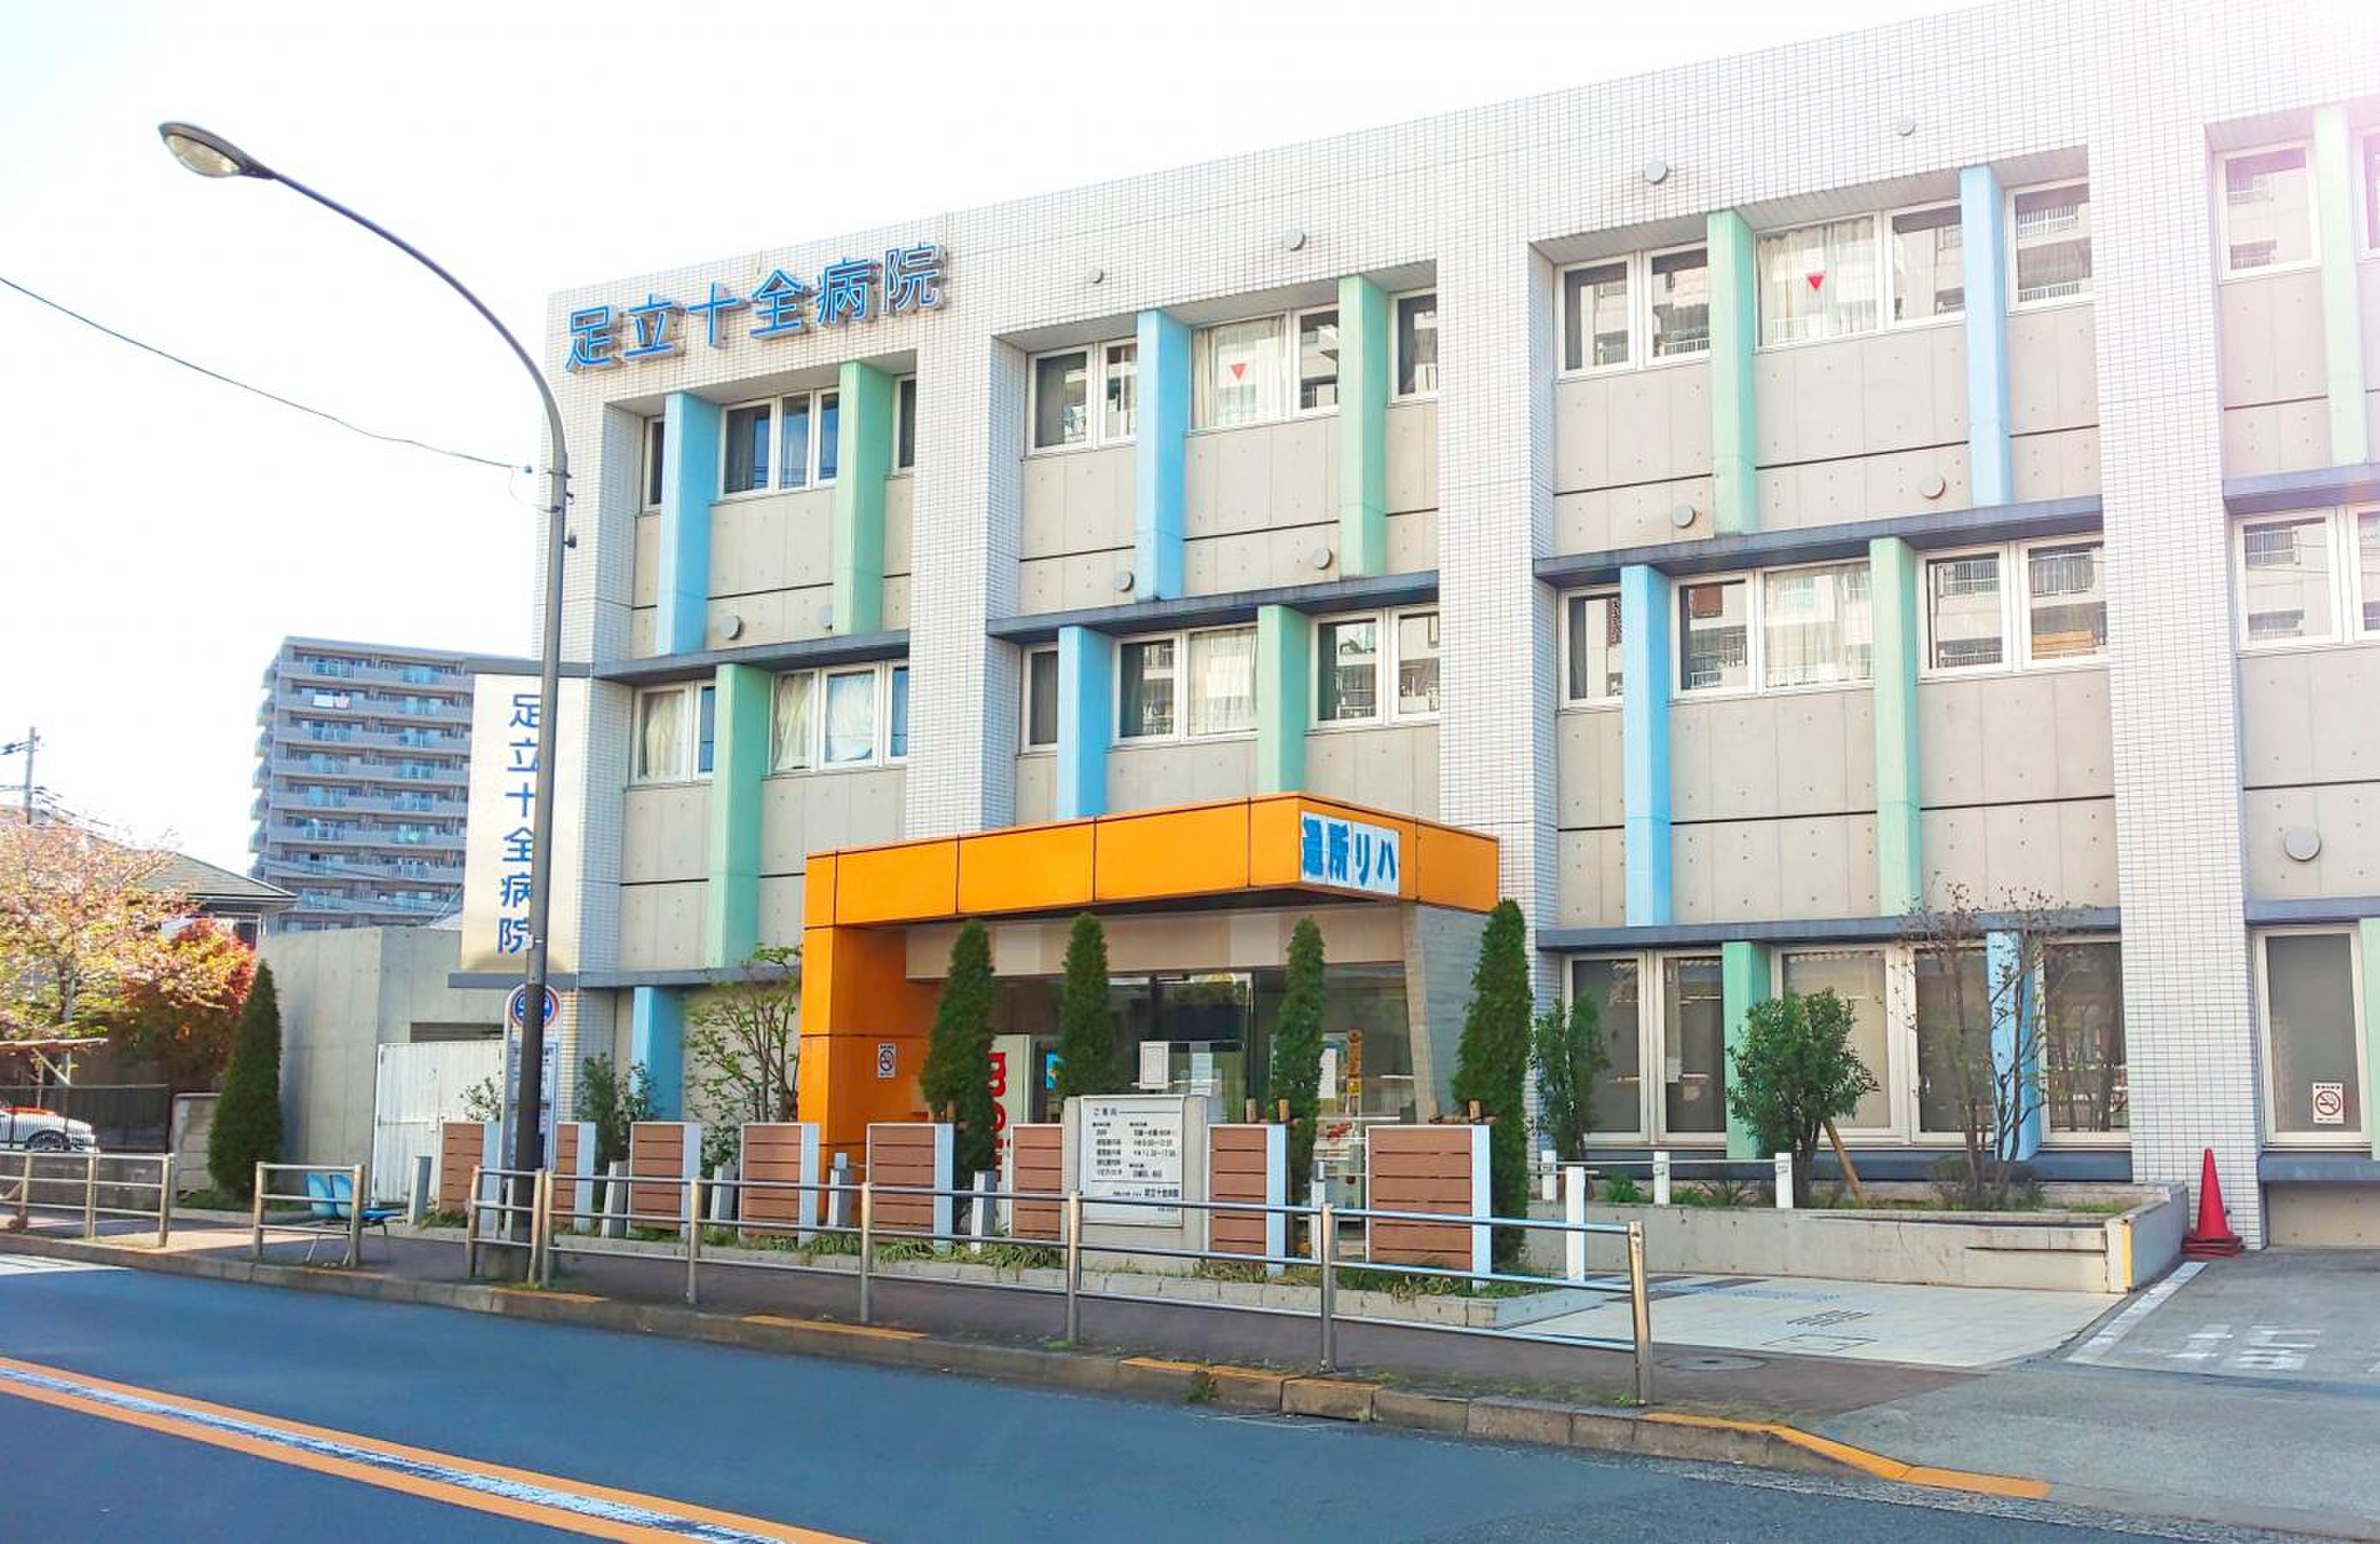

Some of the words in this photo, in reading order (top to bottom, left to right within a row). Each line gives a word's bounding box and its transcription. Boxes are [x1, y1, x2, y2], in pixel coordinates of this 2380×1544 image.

[565, 242, 942, 372] 足立十全病院
